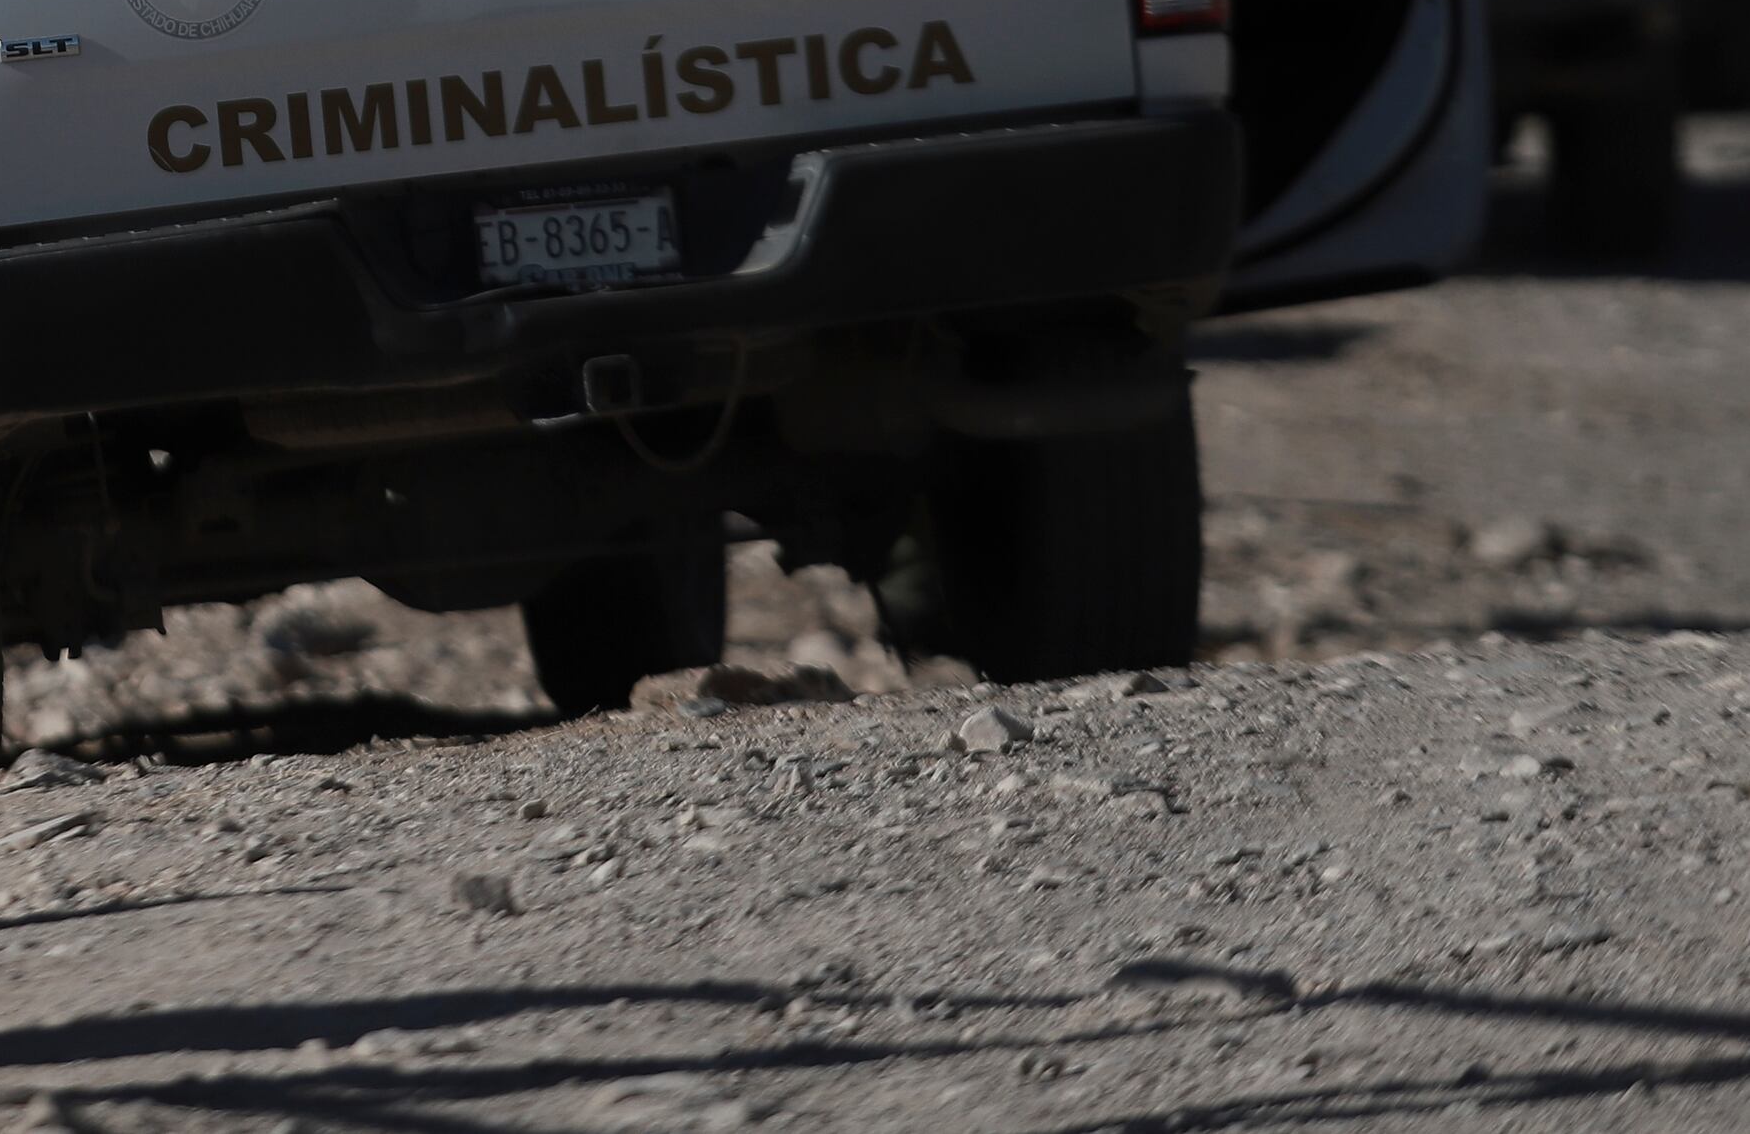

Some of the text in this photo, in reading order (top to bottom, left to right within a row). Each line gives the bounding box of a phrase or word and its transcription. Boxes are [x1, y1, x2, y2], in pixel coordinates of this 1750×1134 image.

[178, 23, 199, 38] DE
[5, 37, 73, 58] SLT
[146, 19, 977, 174] CRIMINALÍSTICA
